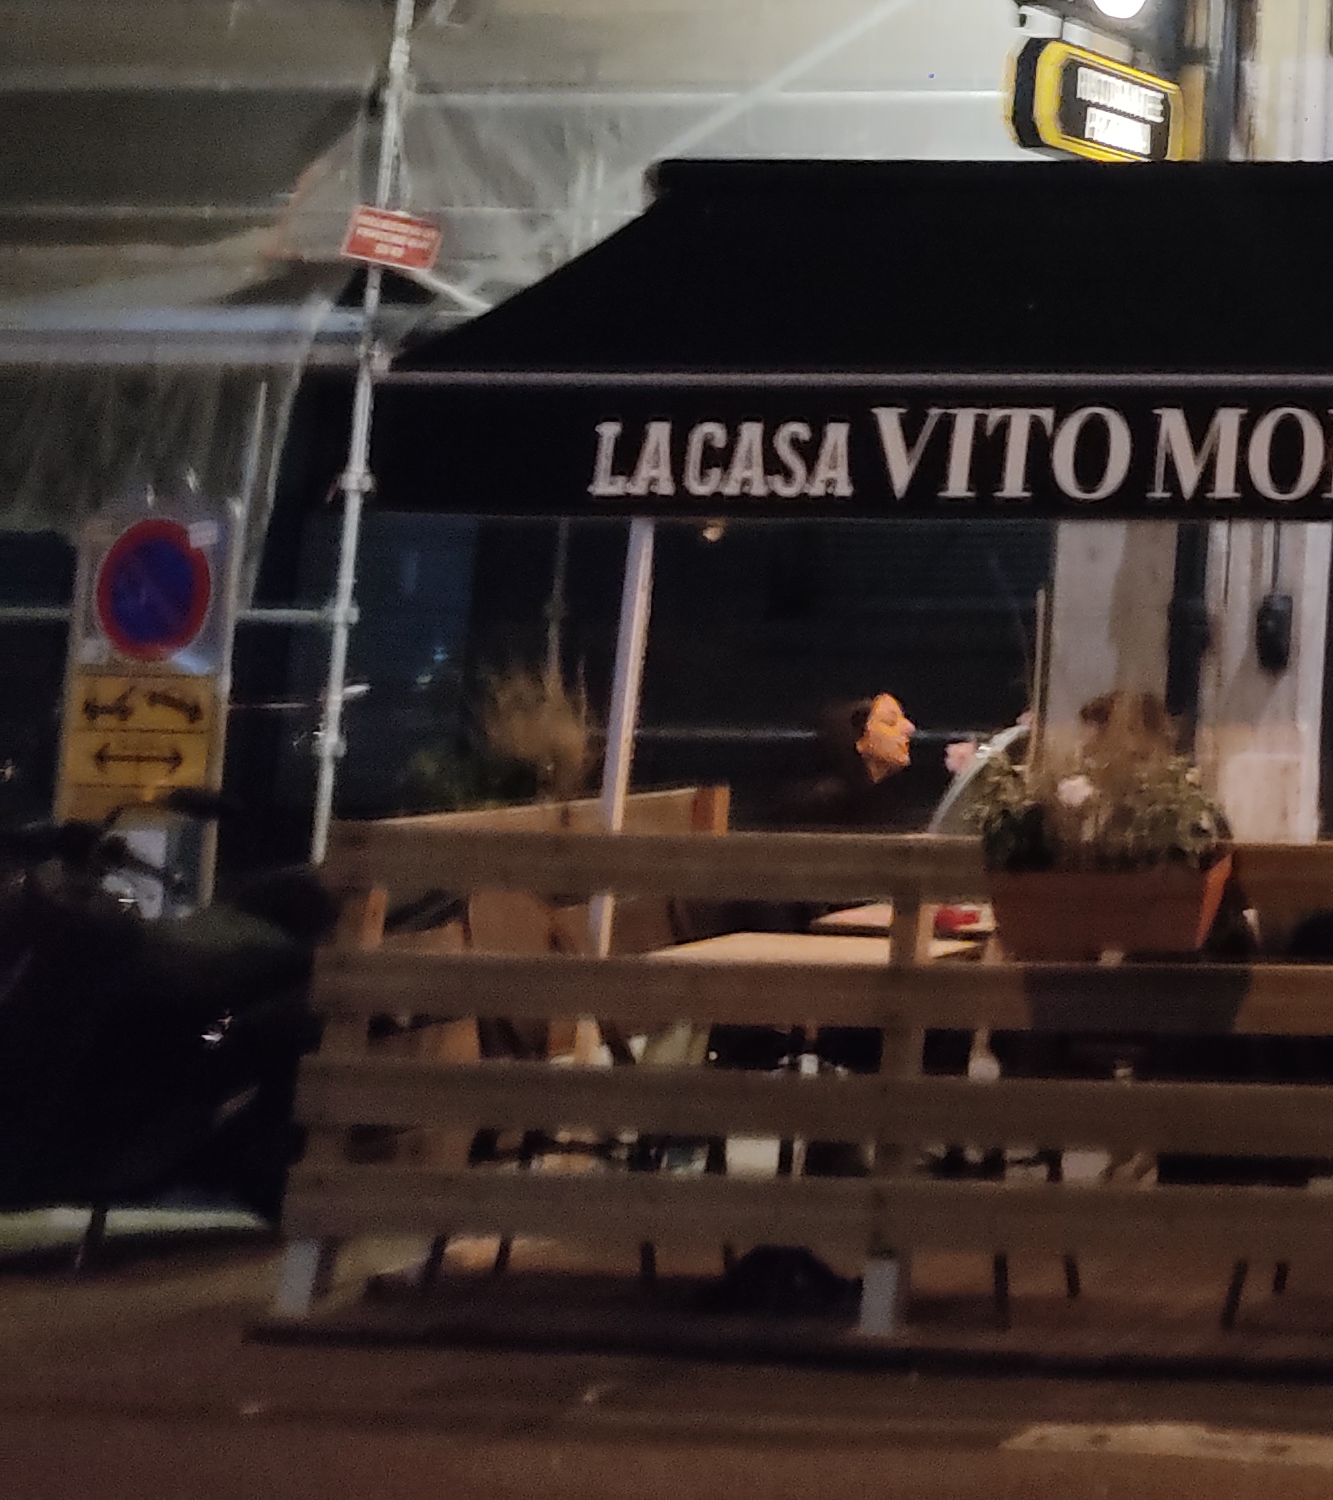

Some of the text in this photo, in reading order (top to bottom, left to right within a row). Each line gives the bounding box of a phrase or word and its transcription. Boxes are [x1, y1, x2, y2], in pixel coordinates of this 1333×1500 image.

[588, 420, 676, 497] LA
[683, 420, 855, 497] CASA
[870, 405, 1133, 500] VITO
